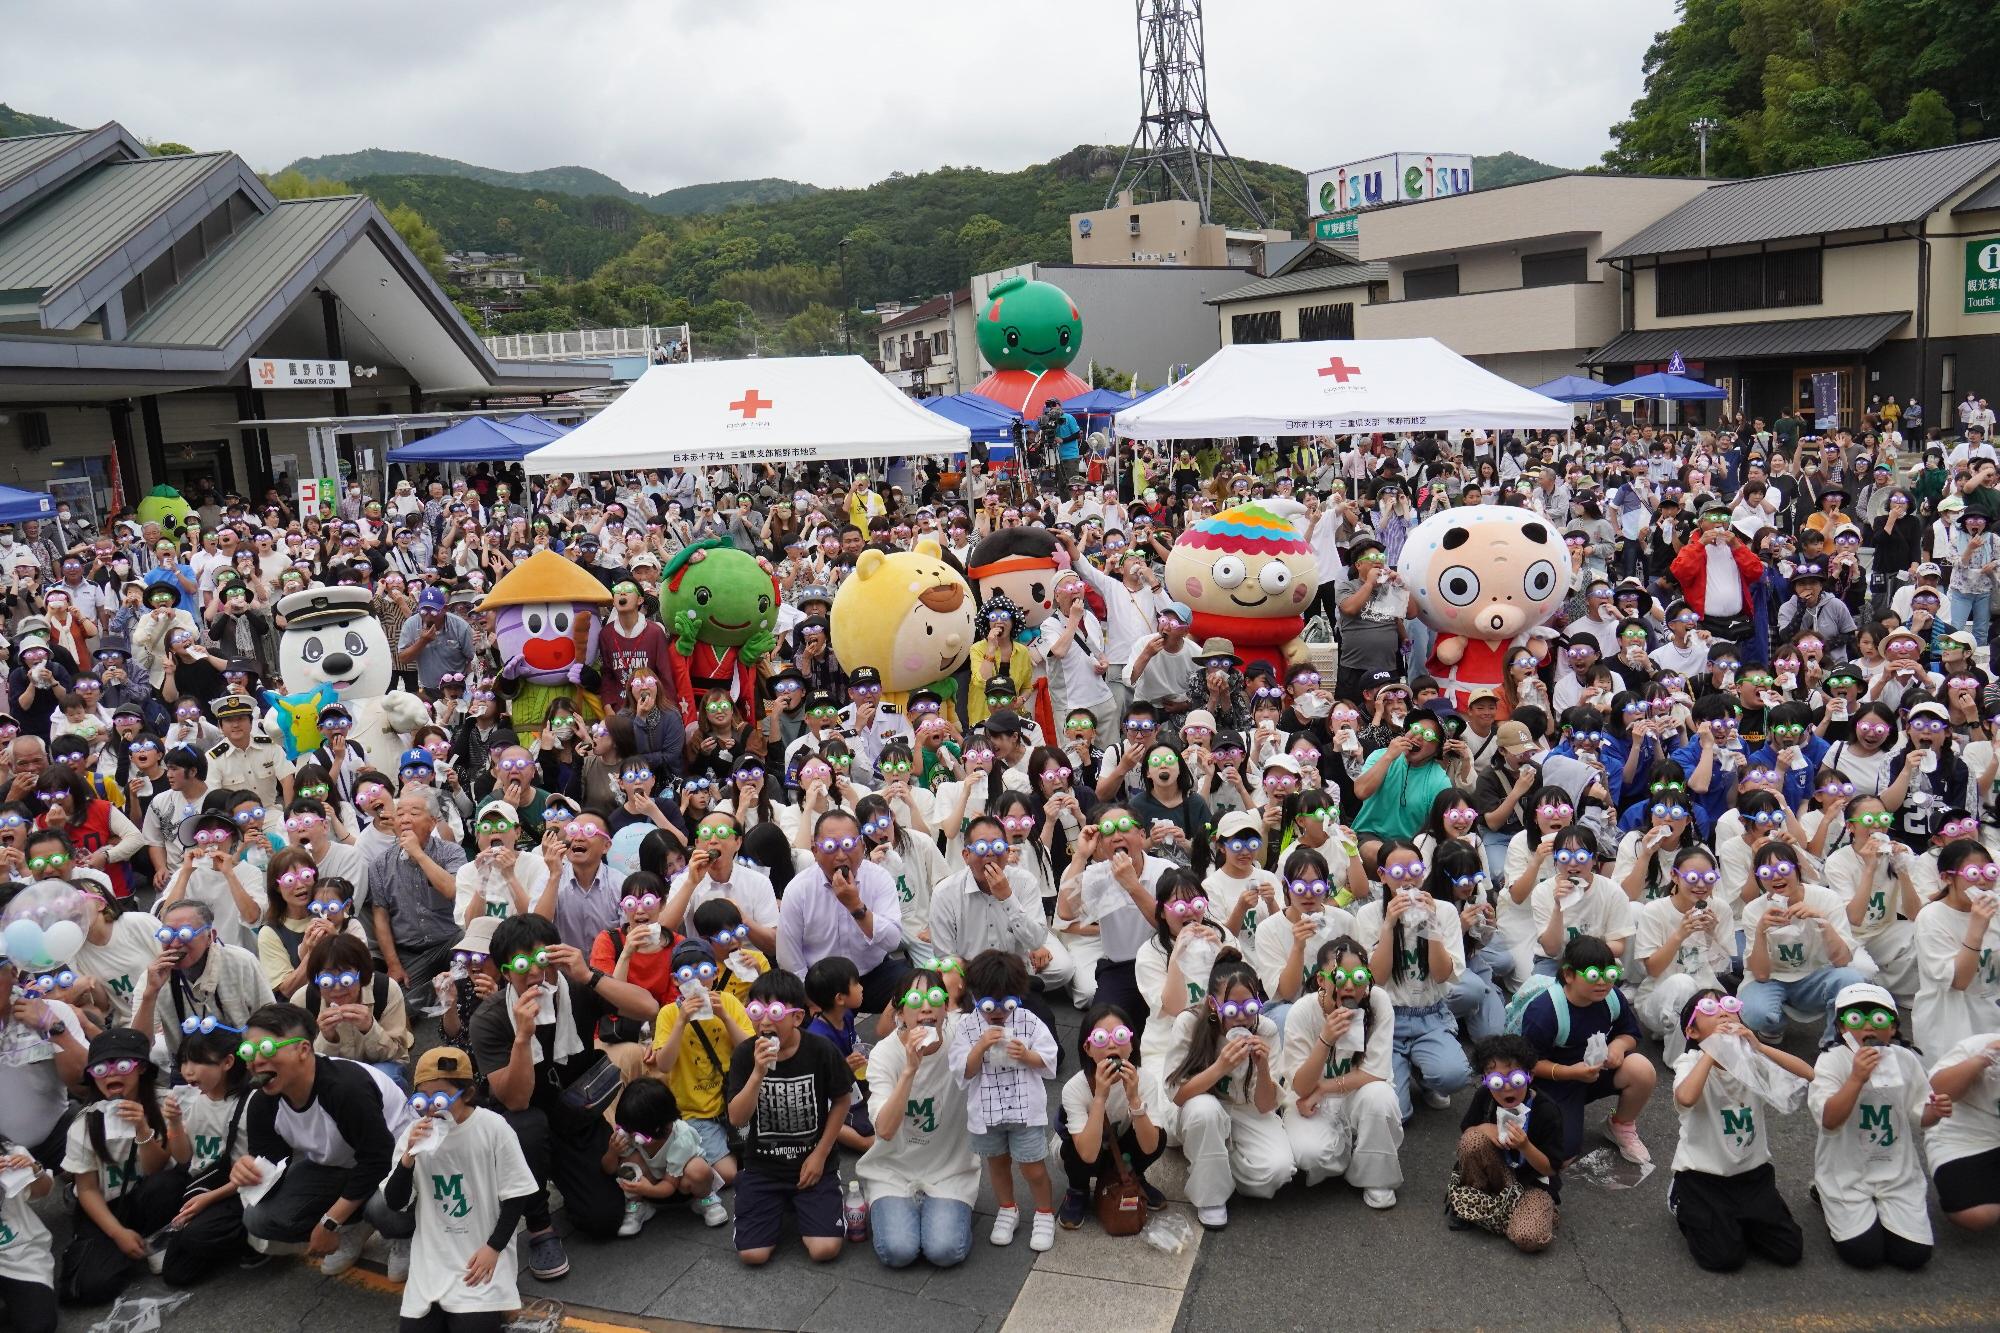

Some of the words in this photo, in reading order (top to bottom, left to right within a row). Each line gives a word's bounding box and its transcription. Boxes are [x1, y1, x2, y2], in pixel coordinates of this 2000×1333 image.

[1405, 157, 1469, 198] eisu
[1319, 168, 1383, 212] eisu
[1967, 278, 2000, 291] 観光案
[1967, 296, 1995, 307] Tourist
[258, 362, 275, 379] JR
[673, 451, 725, 462] 日本赤十字社
[410, 750, 420, 759] NY
[760, 1080, 811, 1096] STREET
[775, 1146, 807, 1156] BROOKLYN
